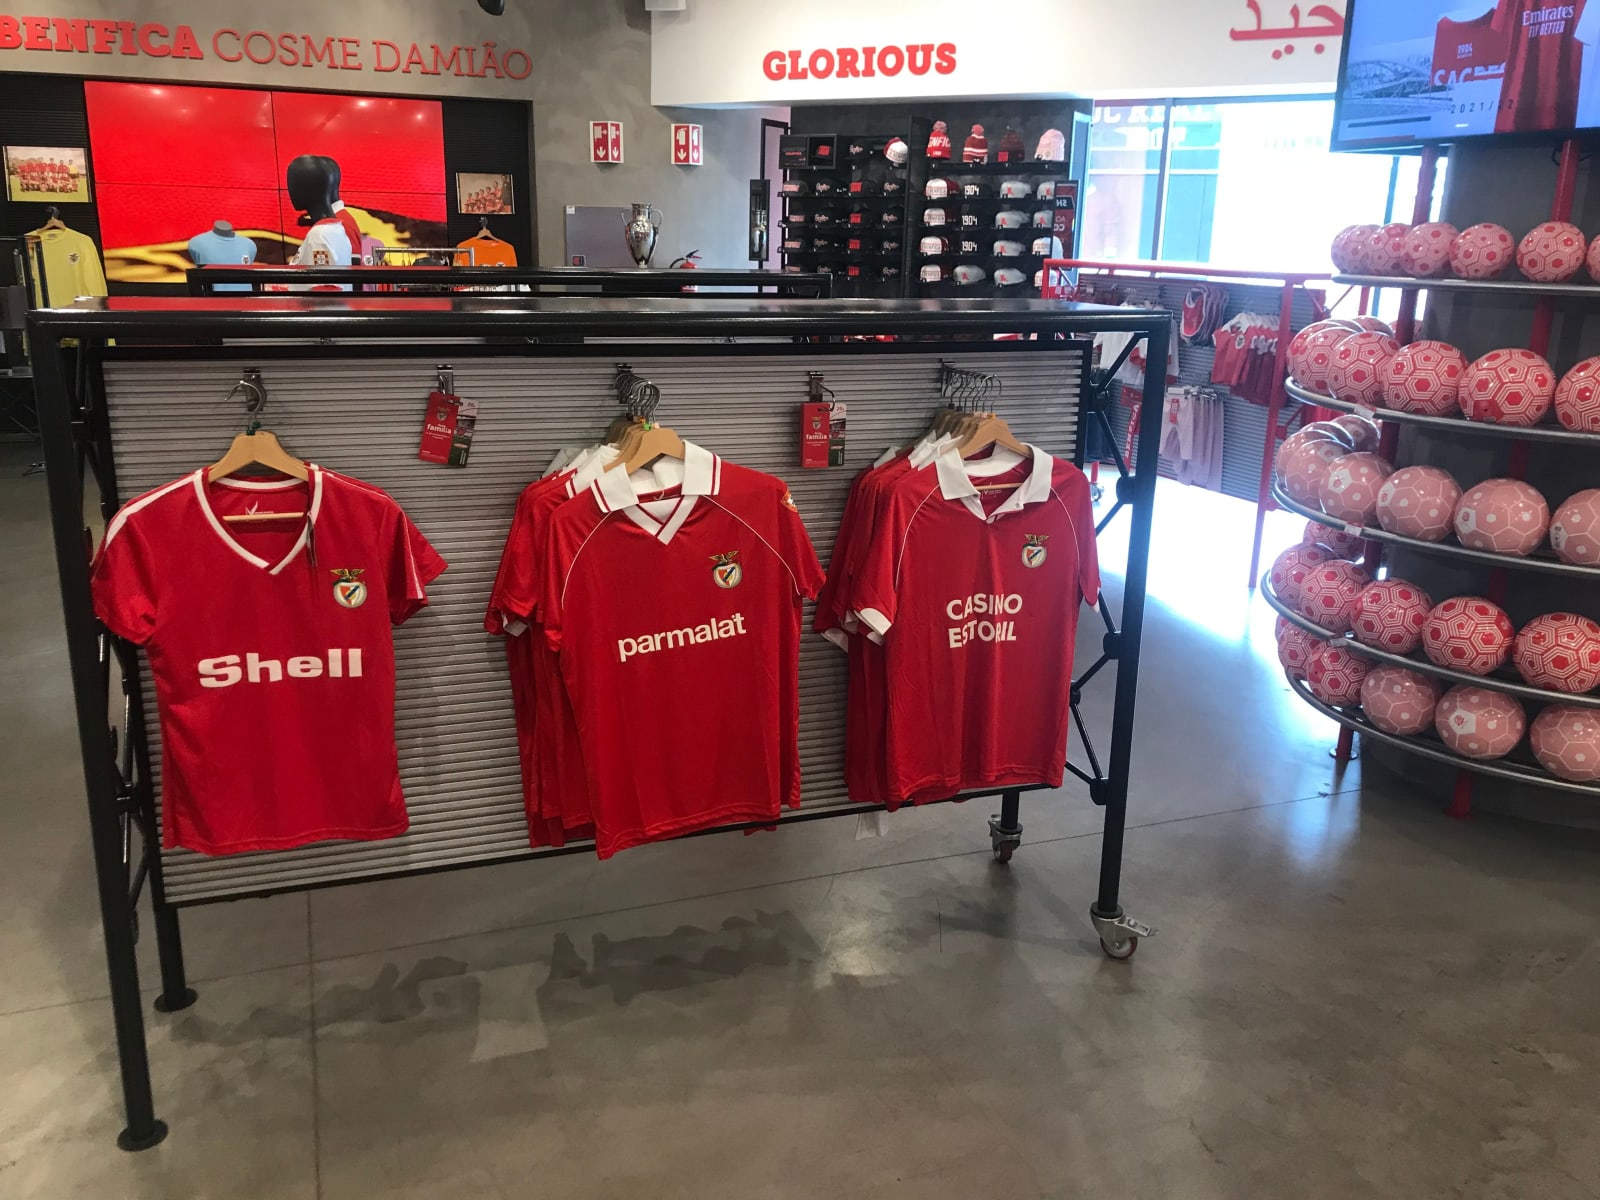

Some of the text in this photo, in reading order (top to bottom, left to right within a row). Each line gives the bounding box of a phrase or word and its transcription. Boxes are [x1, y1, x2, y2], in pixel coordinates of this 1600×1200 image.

[1522, 5, 1575, 26] Emirates
[1540, 21, 1566, 36] BETTER
[0, 15, 532, 80] BENFICA COSME DAMIÃO
[762, 42, 957, 81] GLORIOUS
[964, 184, 980, 196] 1904
[961, 215, 978, 226] 1904
[961, 241, 978, 252] 1904
[946, 592, 1023, 621] CASINO
[617, 612, 747, 663] parmalat
[948, 619, 1017, 649] ESTORIL
[197, 647, 363, 688] Shell
